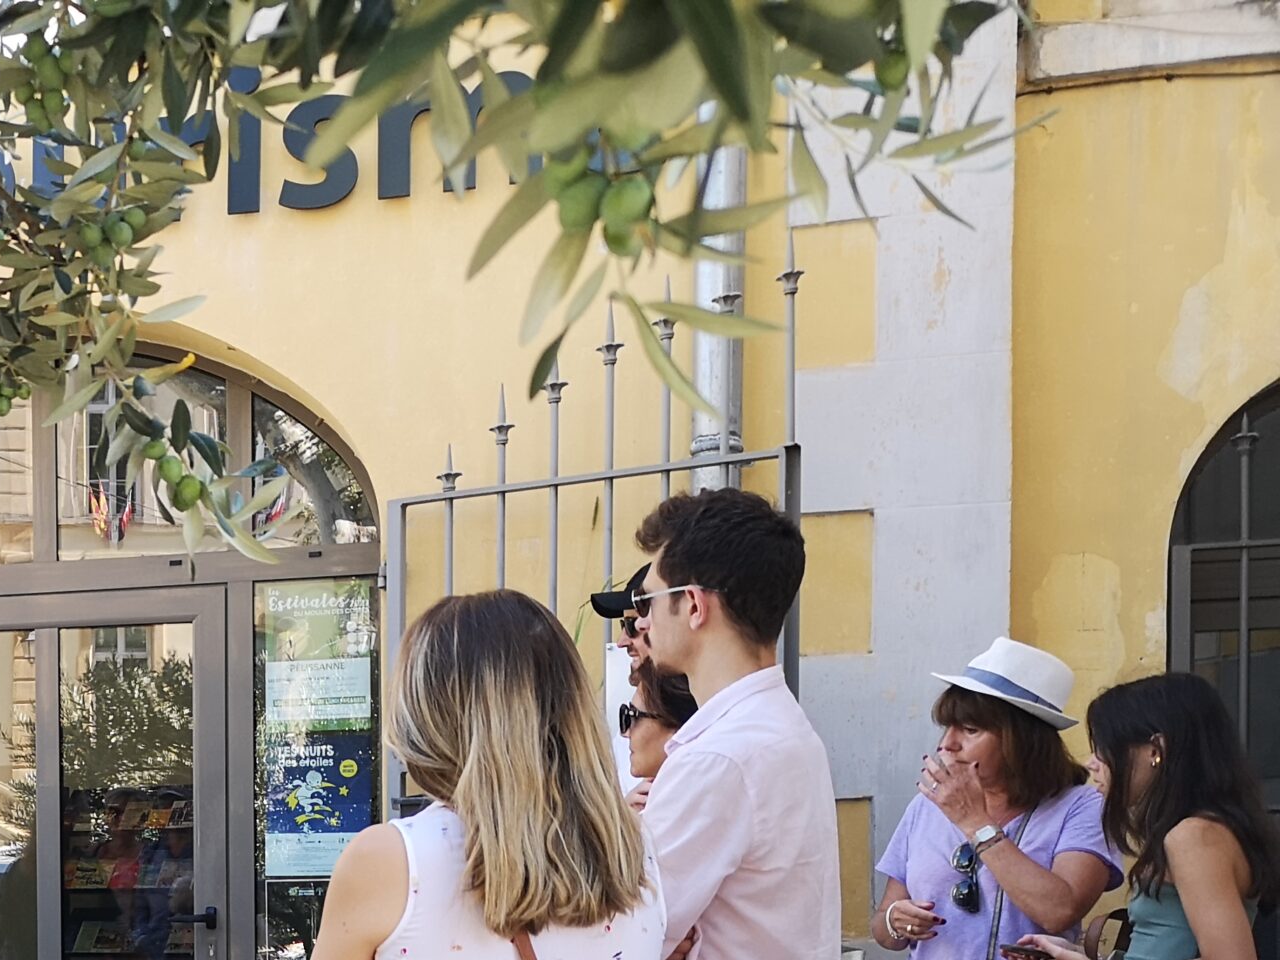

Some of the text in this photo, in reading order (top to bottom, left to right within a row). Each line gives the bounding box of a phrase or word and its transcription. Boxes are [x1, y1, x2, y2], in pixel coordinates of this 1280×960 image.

[268, 592, 346, 612] Estivales
[301, 744, 335, 757] NUITS
[278, 757, 297, 767] des
